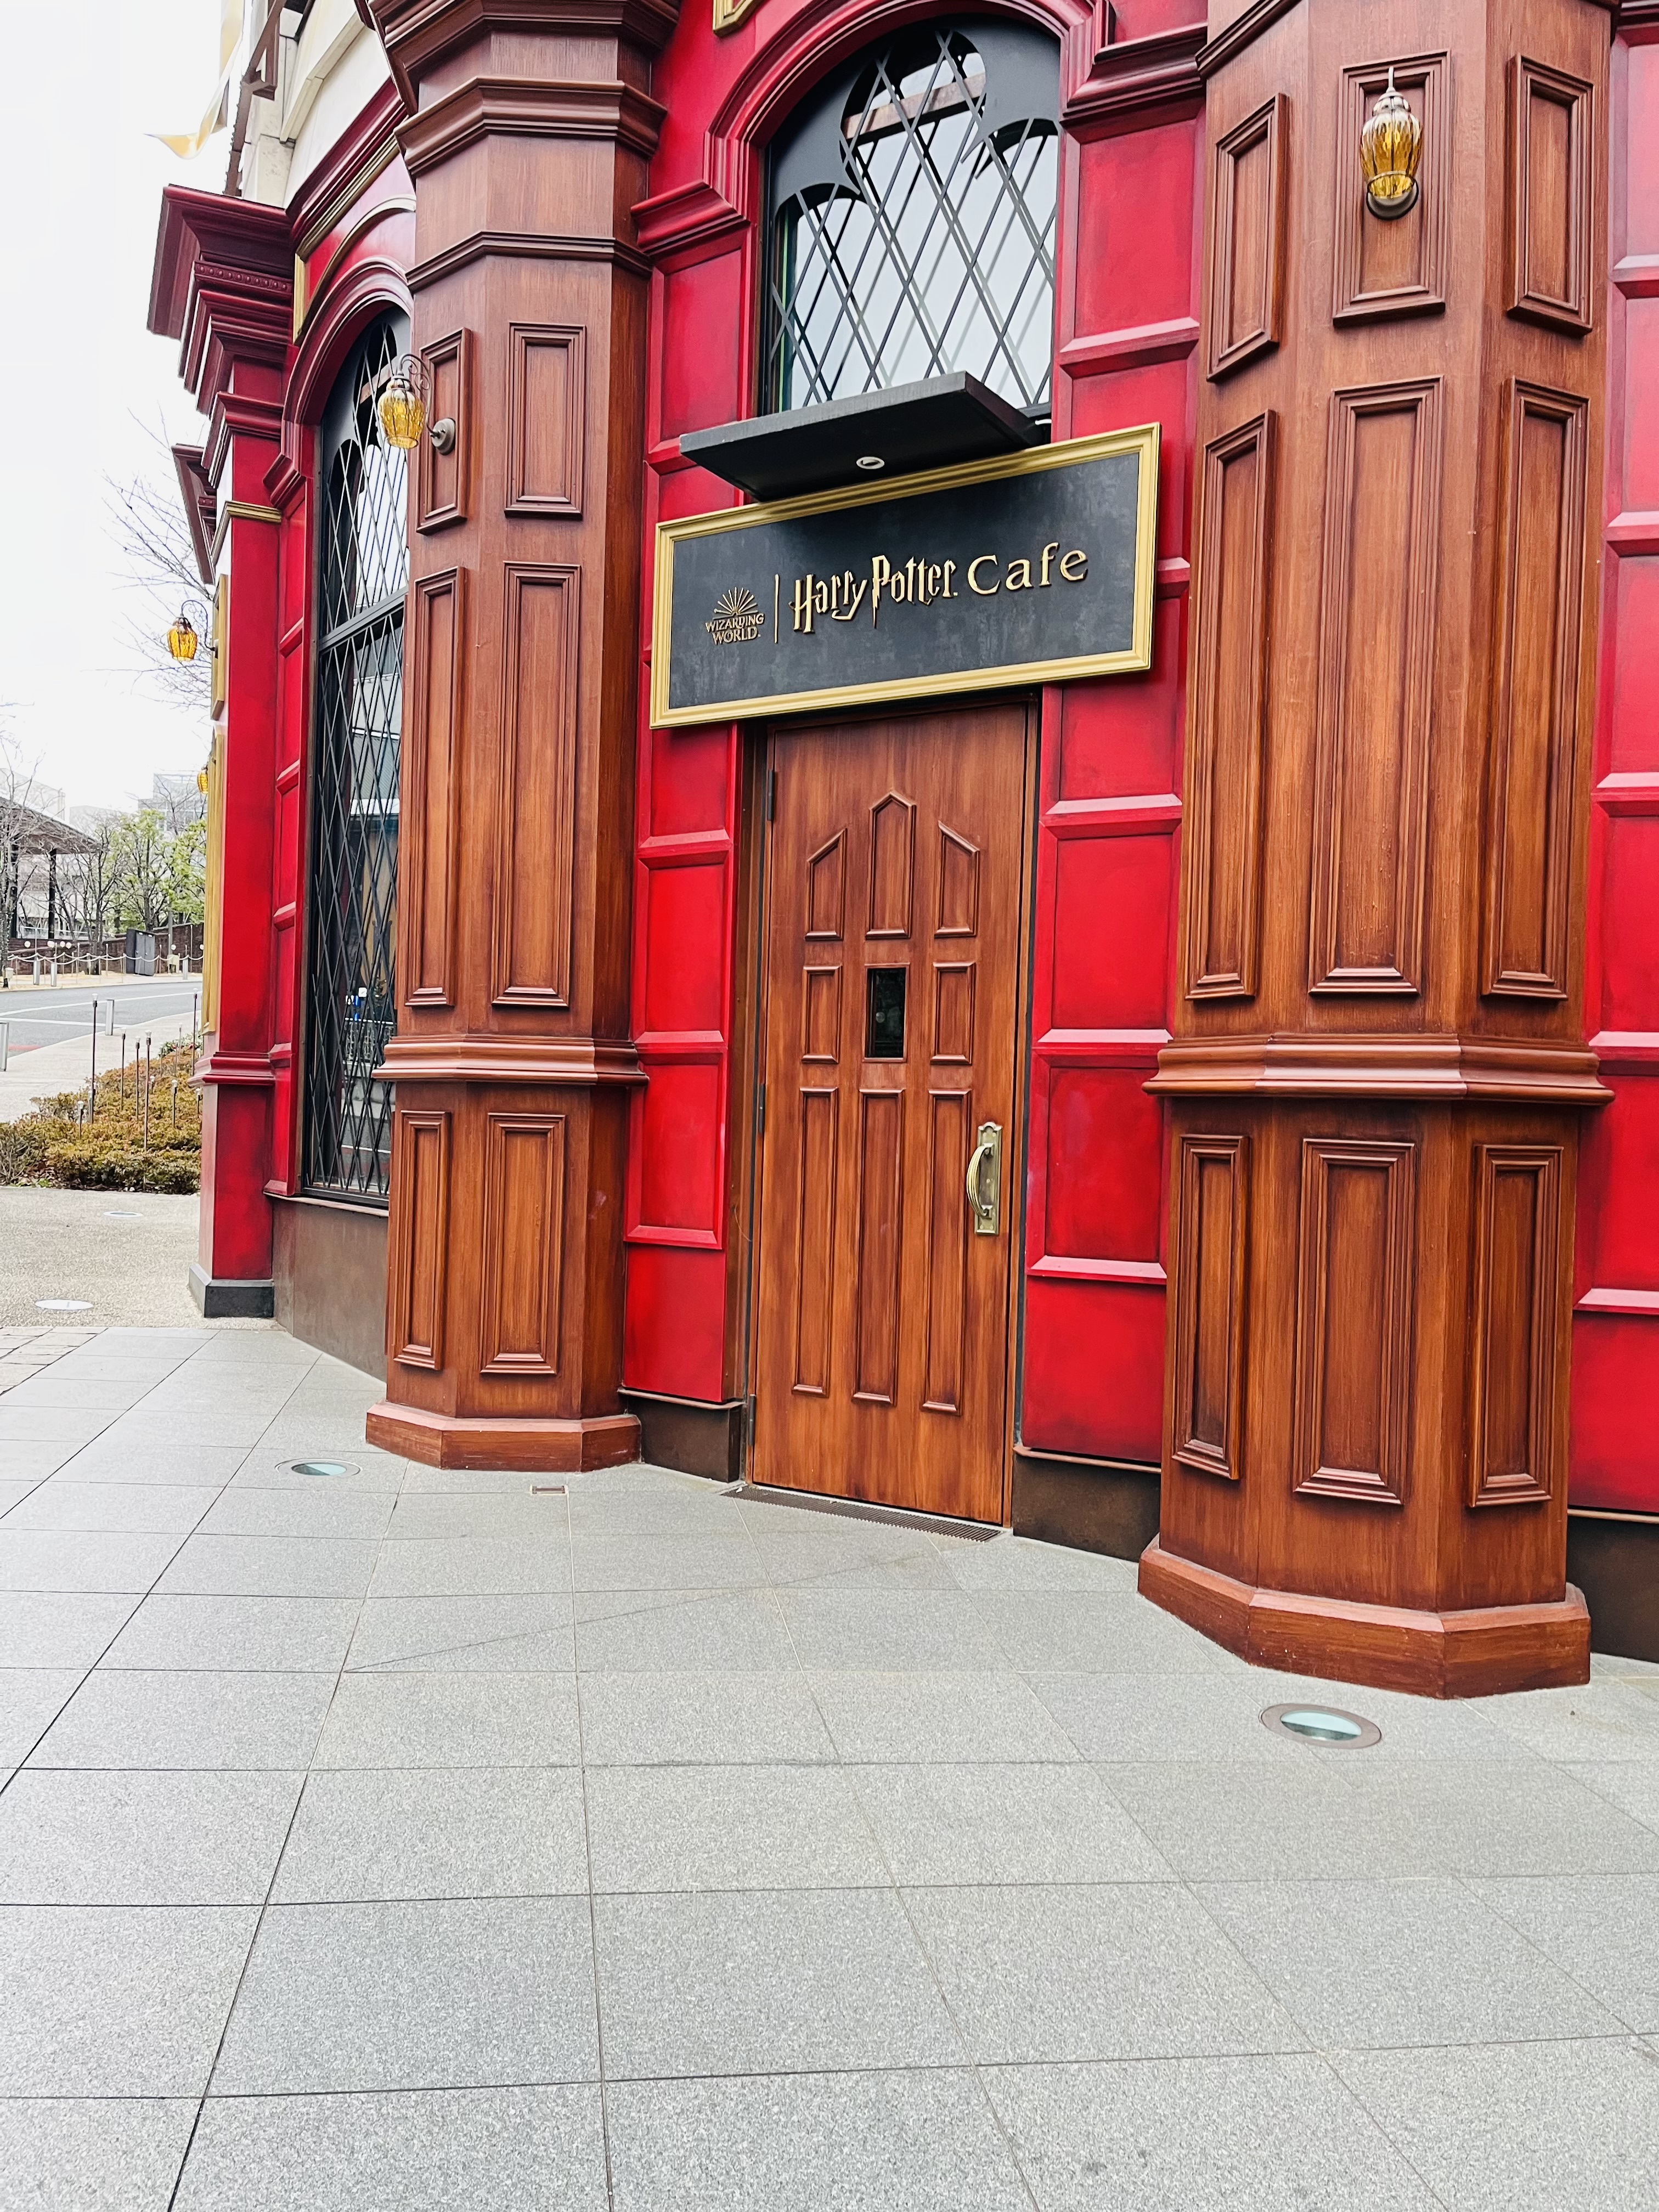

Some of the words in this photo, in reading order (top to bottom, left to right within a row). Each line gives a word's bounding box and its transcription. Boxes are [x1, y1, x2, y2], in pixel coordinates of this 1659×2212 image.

[788, 573, 868, 634] Harry
[967, 541, 1088, 595] Cafe
[705, 613, 765, 633] WIZARDING
